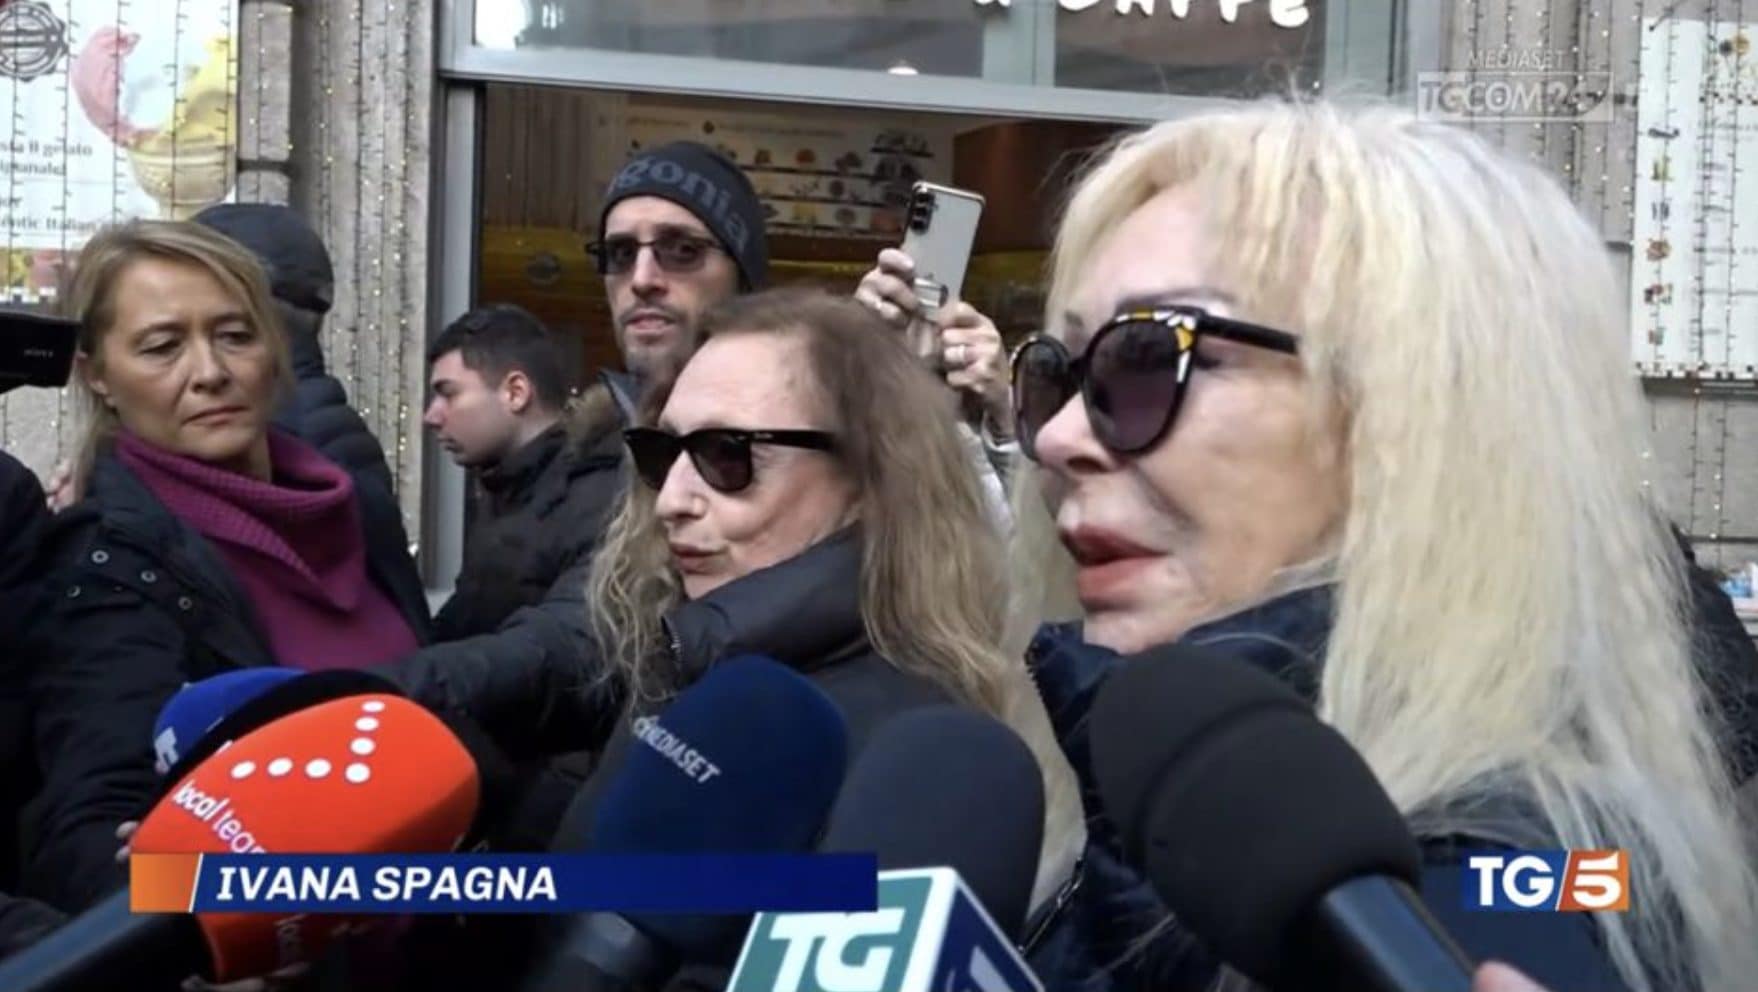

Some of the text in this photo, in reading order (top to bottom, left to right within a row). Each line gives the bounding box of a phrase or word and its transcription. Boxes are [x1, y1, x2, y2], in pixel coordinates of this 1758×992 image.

[607, 157, 747, 253] gonia
[646, 725, 721, 783] MEDIASET
[769, 907, 905, 991] TG
